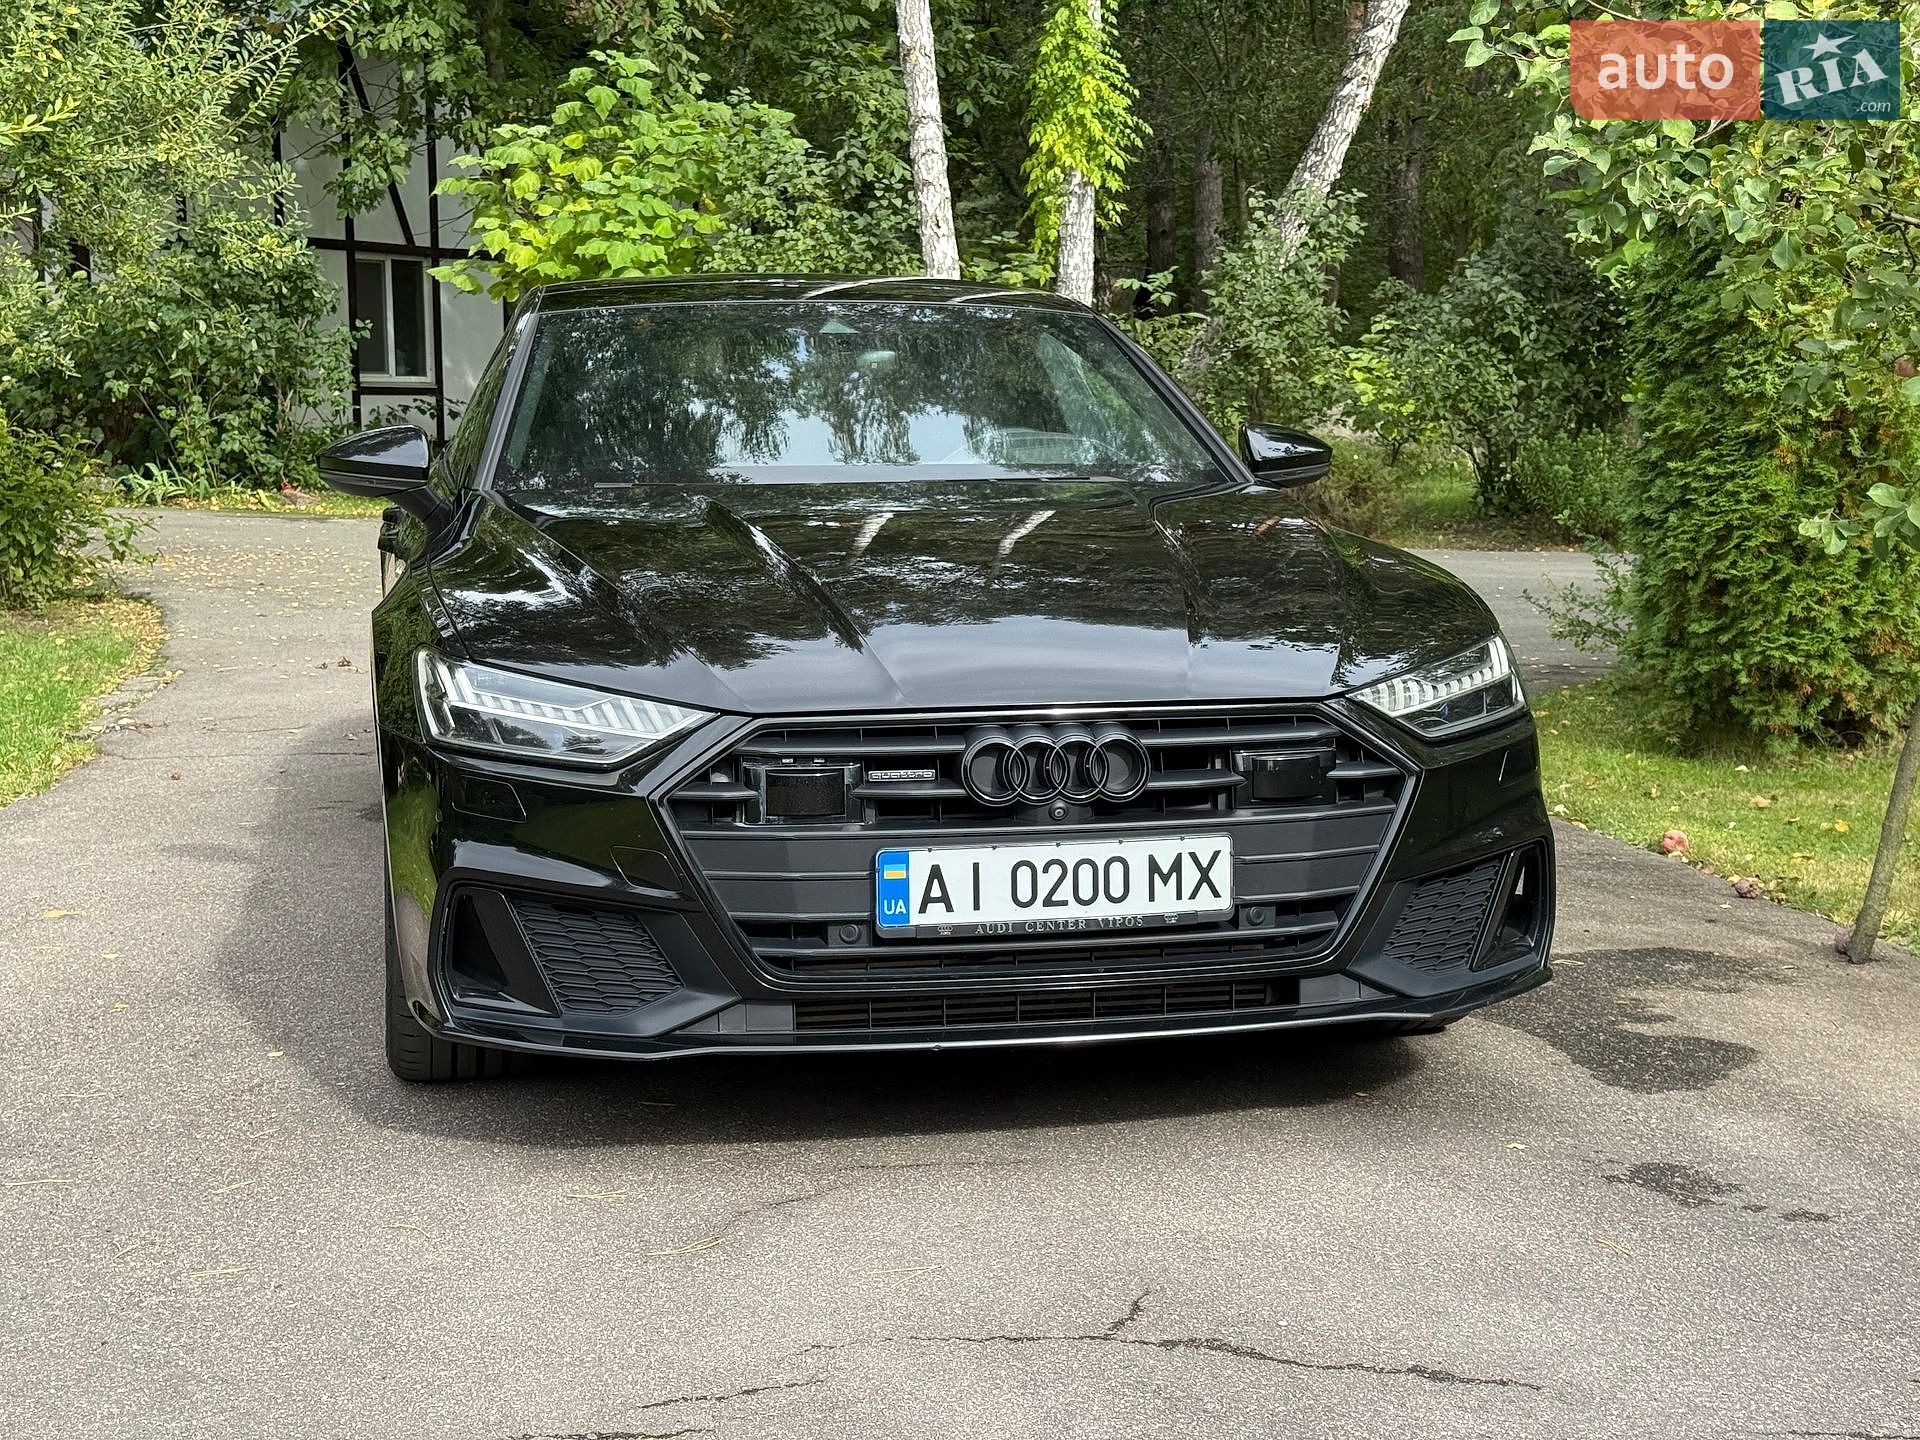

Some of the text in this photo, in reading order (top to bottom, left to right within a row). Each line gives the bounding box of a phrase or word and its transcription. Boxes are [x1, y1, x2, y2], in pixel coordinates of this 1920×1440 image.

[871, 770, 933, 780] quattro
[1010, 855, 1130, 909] 0200
[1148, 850, 1222, 902] MX
[884, 899, 907, 914] UA
[975, 916, 1144, 934] AUDI CENTER VIPOS
